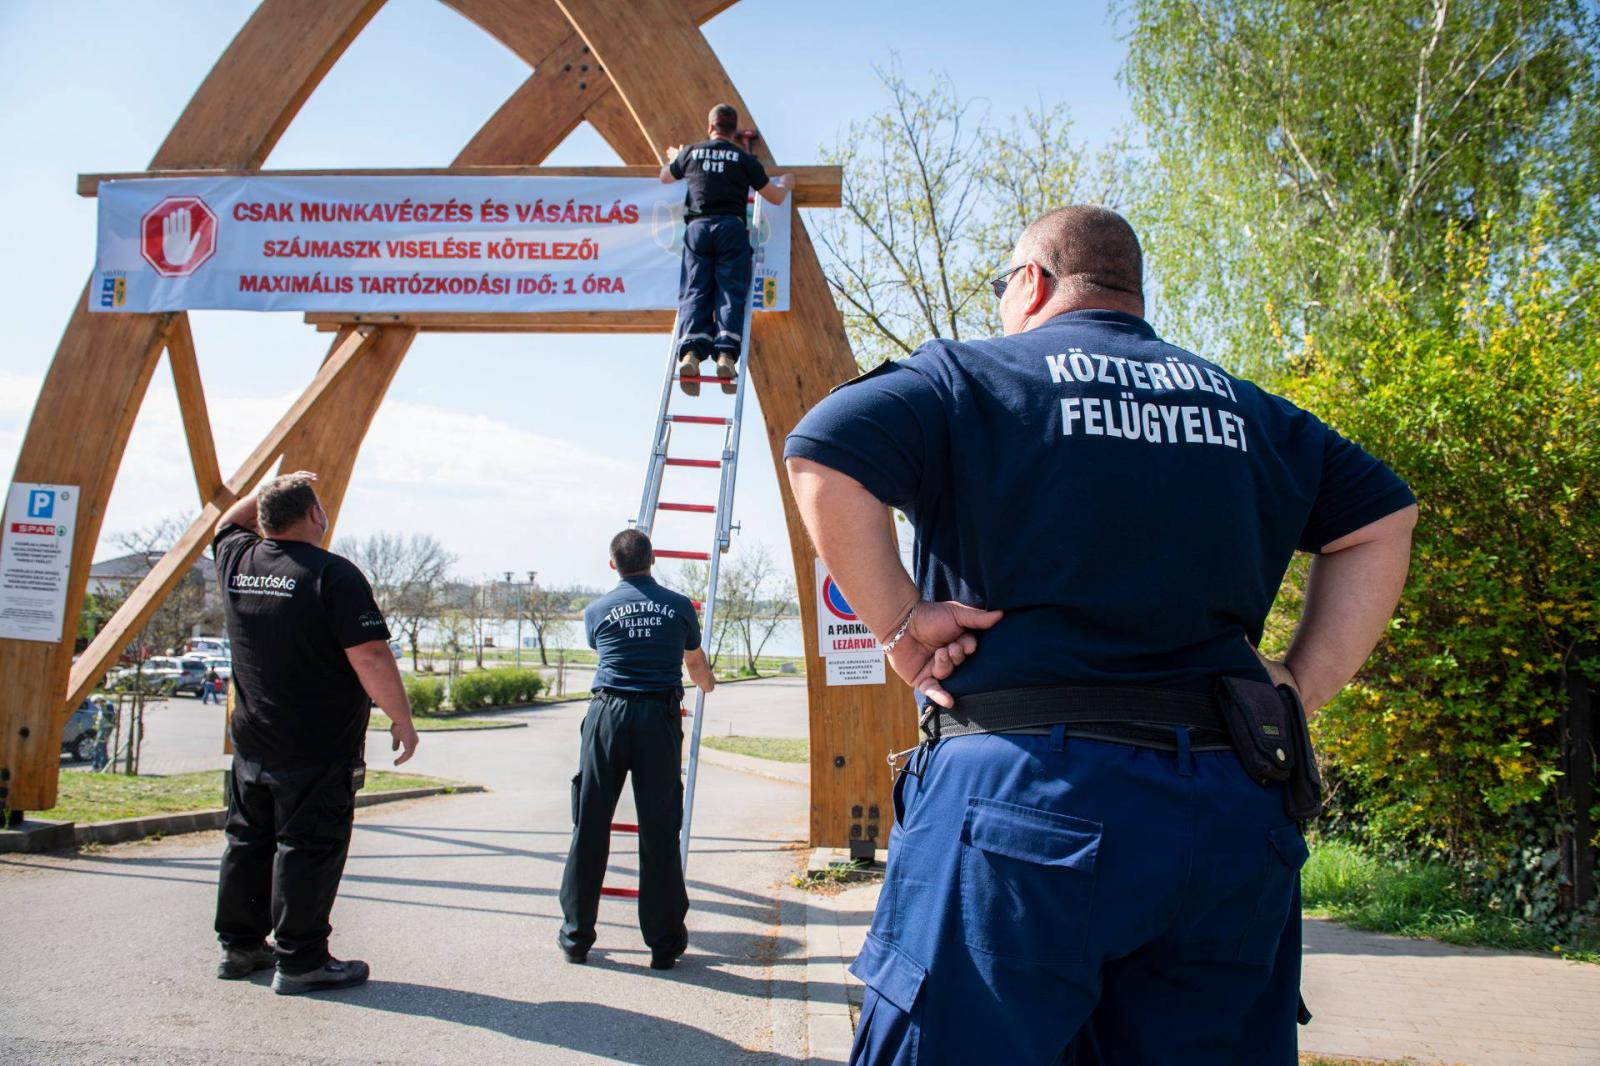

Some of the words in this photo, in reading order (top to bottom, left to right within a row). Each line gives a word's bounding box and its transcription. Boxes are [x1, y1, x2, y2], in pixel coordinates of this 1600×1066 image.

[691, 149, 739, 162] VELENCE
[233, 202, 293, 222] CSAK
[300, 198, 473, 223] MUNKAVÉGZÉS
[480, 198, 510, 223] ÉS
[515, 200, 640, 224] VÁSÁRLÁS
[263, 237, 382, 259] SZÁJMASZK
[387, 237, 481, 260] VISELÉSE
[486, 237, 600, 261] KÖTELEZŐ!
[239, 271, 354, 294] MAXIMÁLIS
[359, 272, 511, 295] TARTÓZKODÁSI
[516, 273, 558, 294] IDŐ:
[563, 278, 577, 294] 1
[582, 273, 626, 294] ÓRA
[1045, 348, 1238, 403] KÖZTERÜLET
[1060, 392, 1248, 452] FELÜGYELET
[33, 492, 50, 516] P
[18, 524, 55, 535] SPAR
[619, 617, 662, 628] VELENCE
[828, 625, 835, 636] A
[628, 627, 651, 638] ÖTE
[833, 637, 876, 650] LEZÁRVA!
